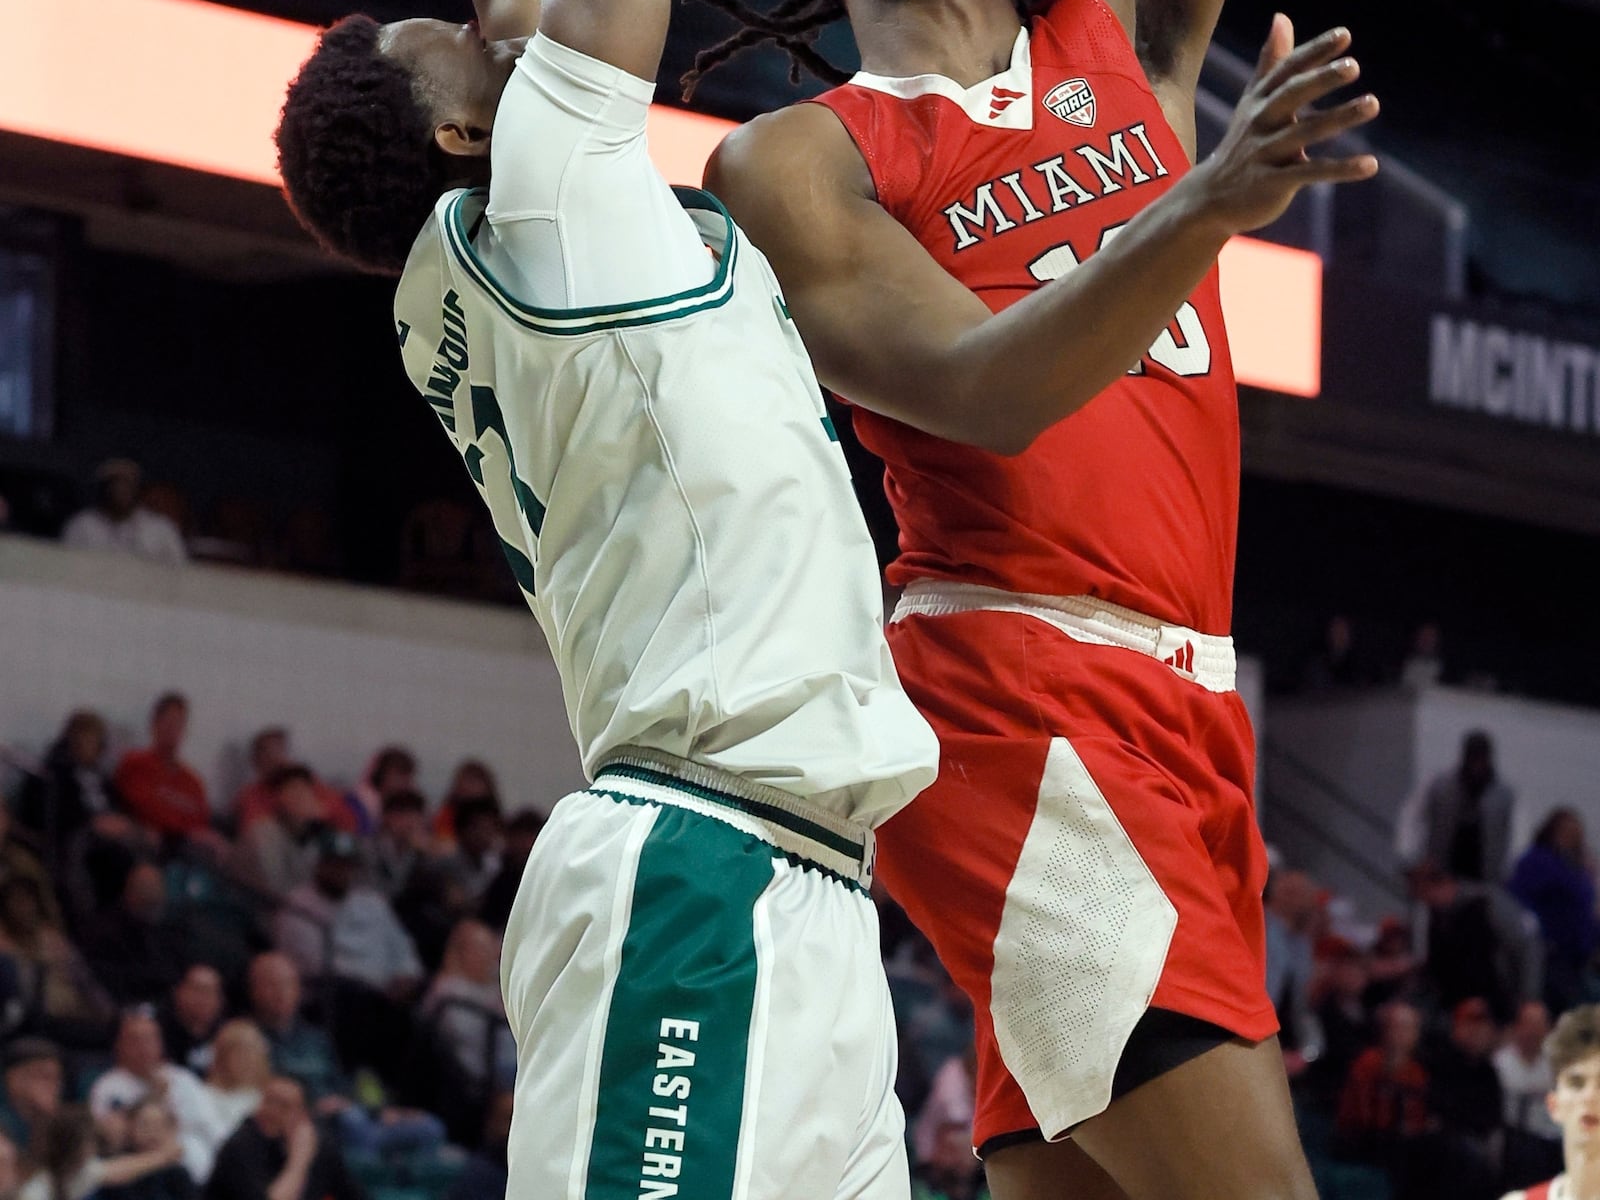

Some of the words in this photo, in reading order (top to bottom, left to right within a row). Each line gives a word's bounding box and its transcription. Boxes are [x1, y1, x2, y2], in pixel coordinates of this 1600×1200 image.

[1053, 88, 1093, 117] MAC
[942, 122, 1170, 252] MIAMI
[1430, 312, 1600, 436] MCINT
[637, 1017, 700, 1200] EASTERN
